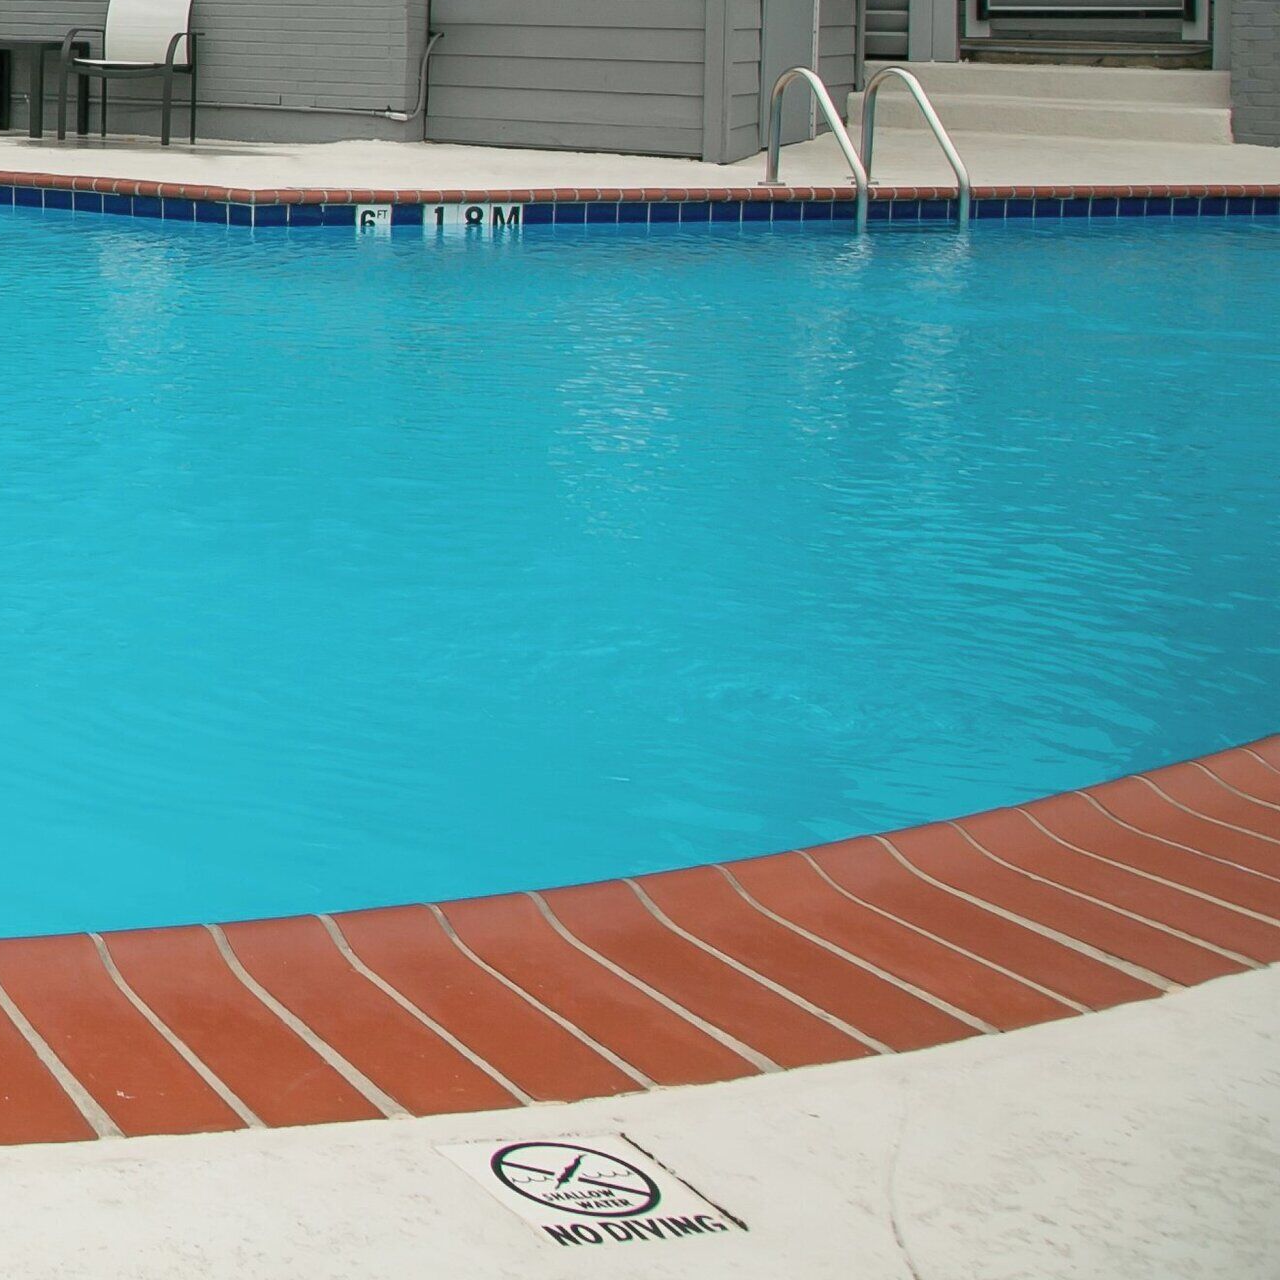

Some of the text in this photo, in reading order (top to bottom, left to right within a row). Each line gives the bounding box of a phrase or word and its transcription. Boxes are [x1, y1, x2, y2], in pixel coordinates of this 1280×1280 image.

[542, 1189, 615, 1202] SHALLOW
[574, 1198, 634, 1210] WATER
[541, 1215, 729, 1247] NO DIVING
